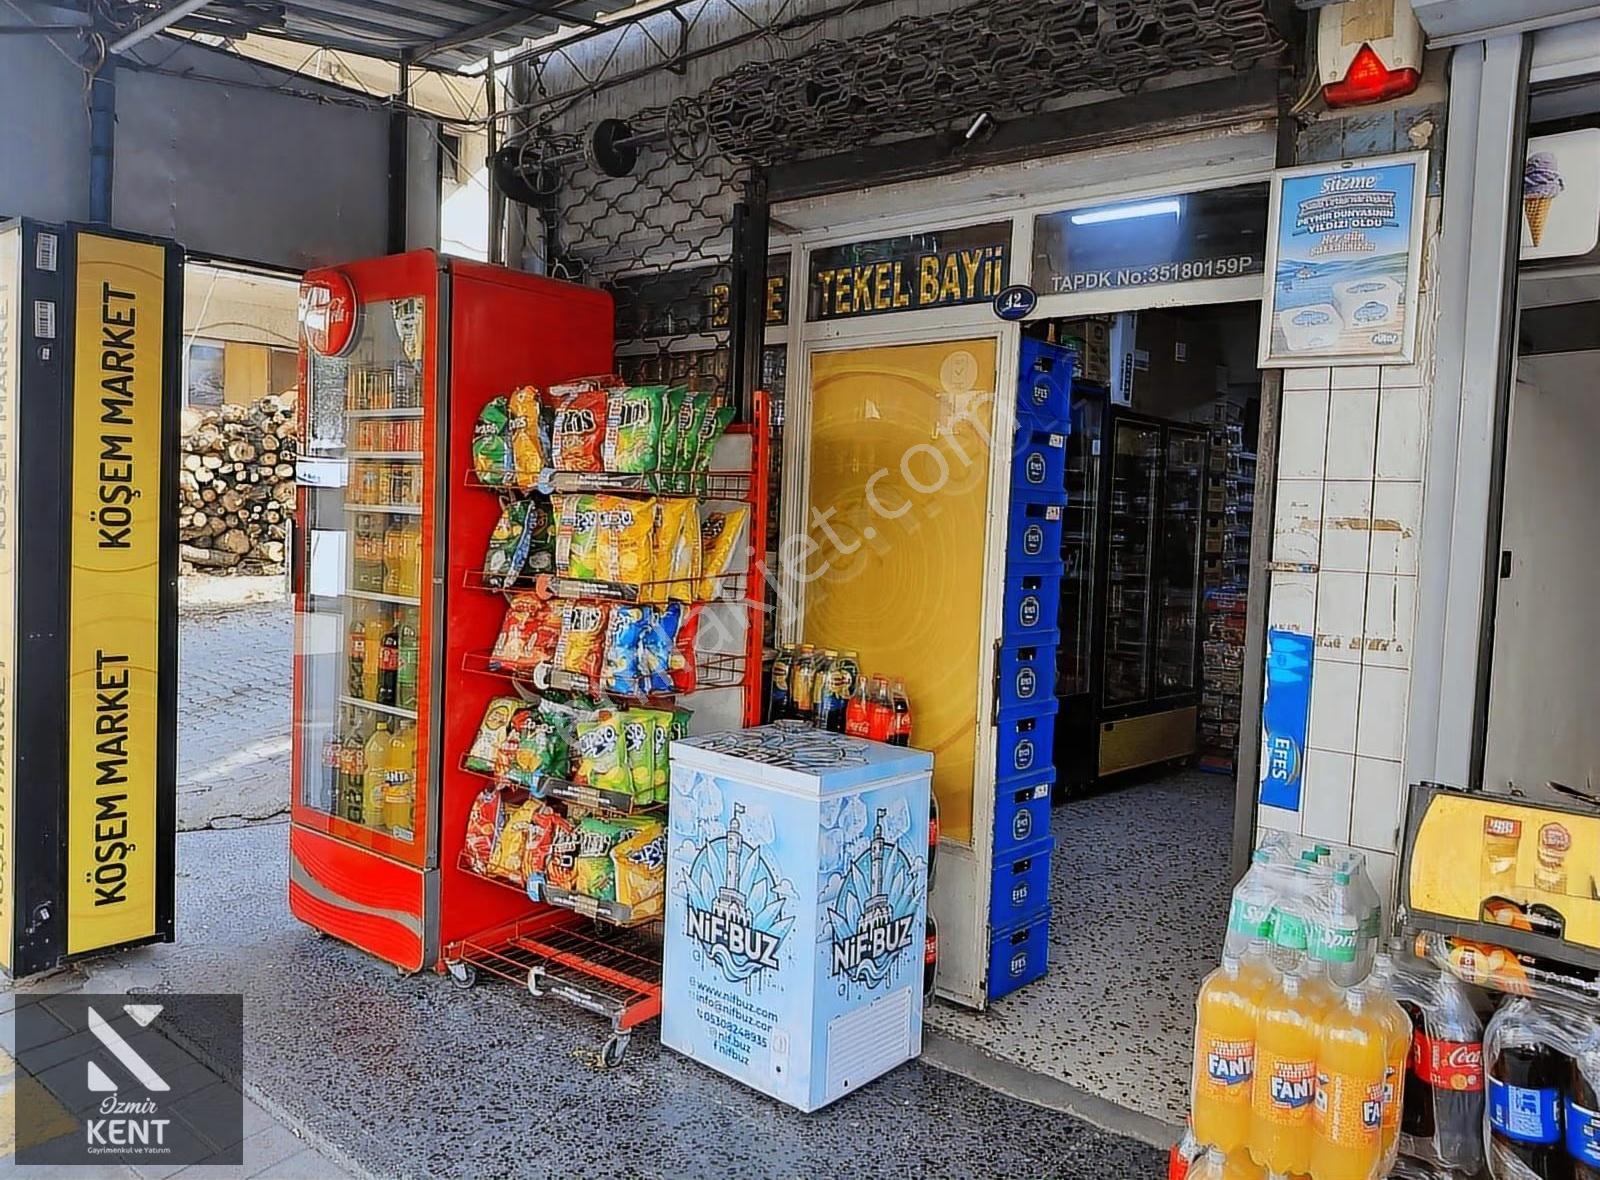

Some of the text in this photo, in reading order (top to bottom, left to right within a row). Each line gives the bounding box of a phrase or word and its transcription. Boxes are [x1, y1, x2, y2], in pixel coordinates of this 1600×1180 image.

[1320, 175, 1376, 194] Süzme
[1351, 218, 1382, 228] OLDU
[817, 260, 910, 316] TEKEL
[1051, 255, 1253, 292] TAPDK No:35180159P
[89, 281, 141, 549] KÖŞEM MARKET
[86, 649, 136, 908] KÖŞEM MARKET
[1271, 737, 1291, 781] EFES
[697, 981, 778, 1023] www.nifbuz.com
